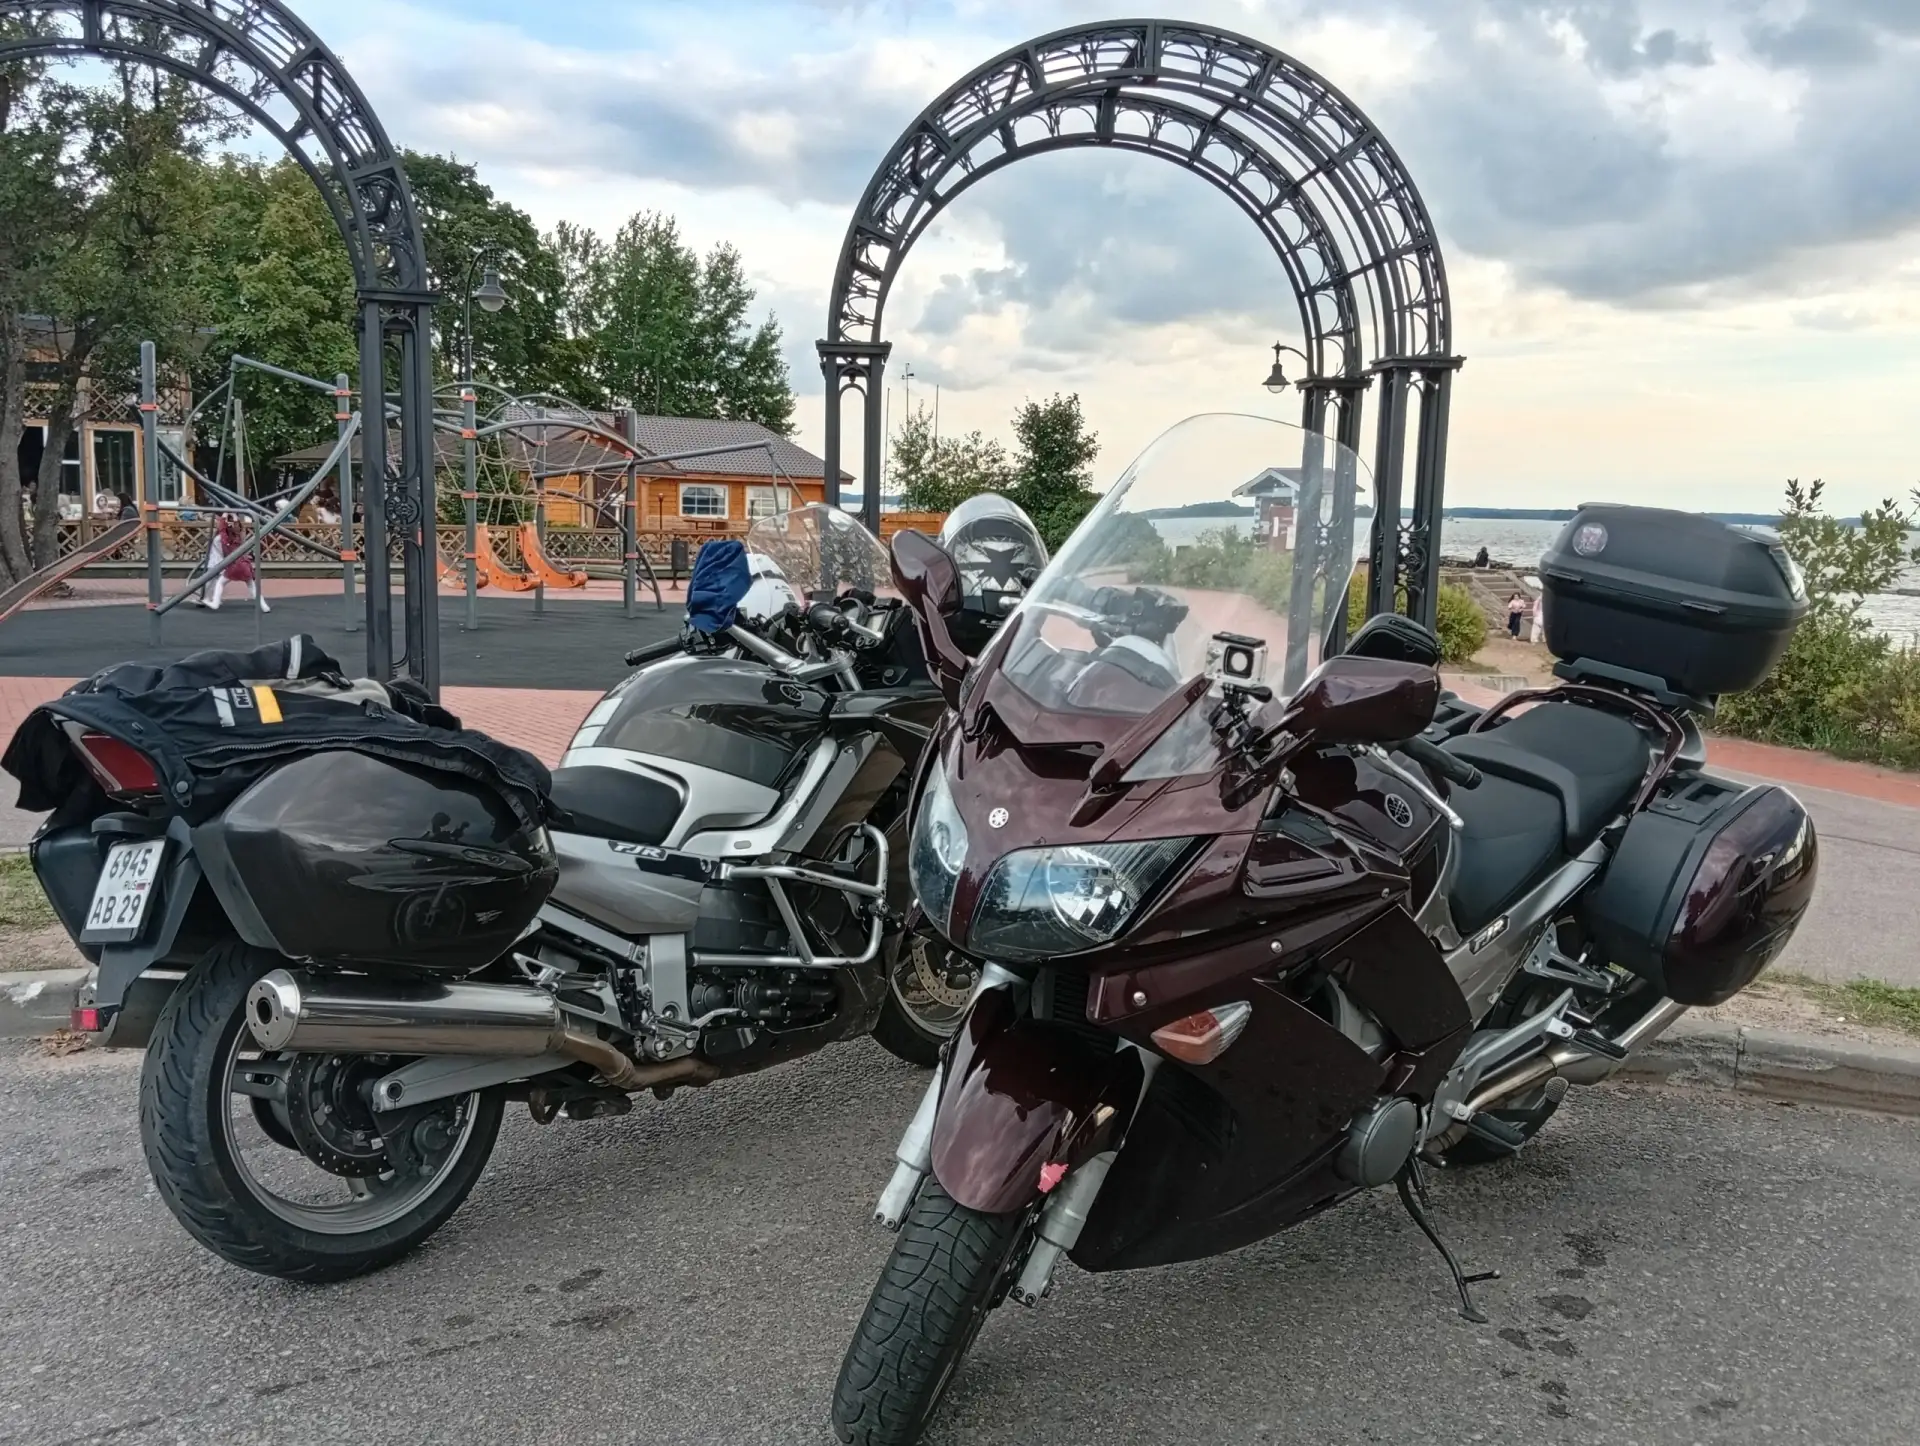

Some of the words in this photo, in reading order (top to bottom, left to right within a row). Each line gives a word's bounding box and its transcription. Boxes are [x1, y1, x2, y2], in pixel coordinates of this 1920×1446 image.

[109, 848, 153, 879] 6945
[613, 842, 662, 858] FJR
[90, 896, 117, 924] AB
[117, 894, 142, 923] 29
